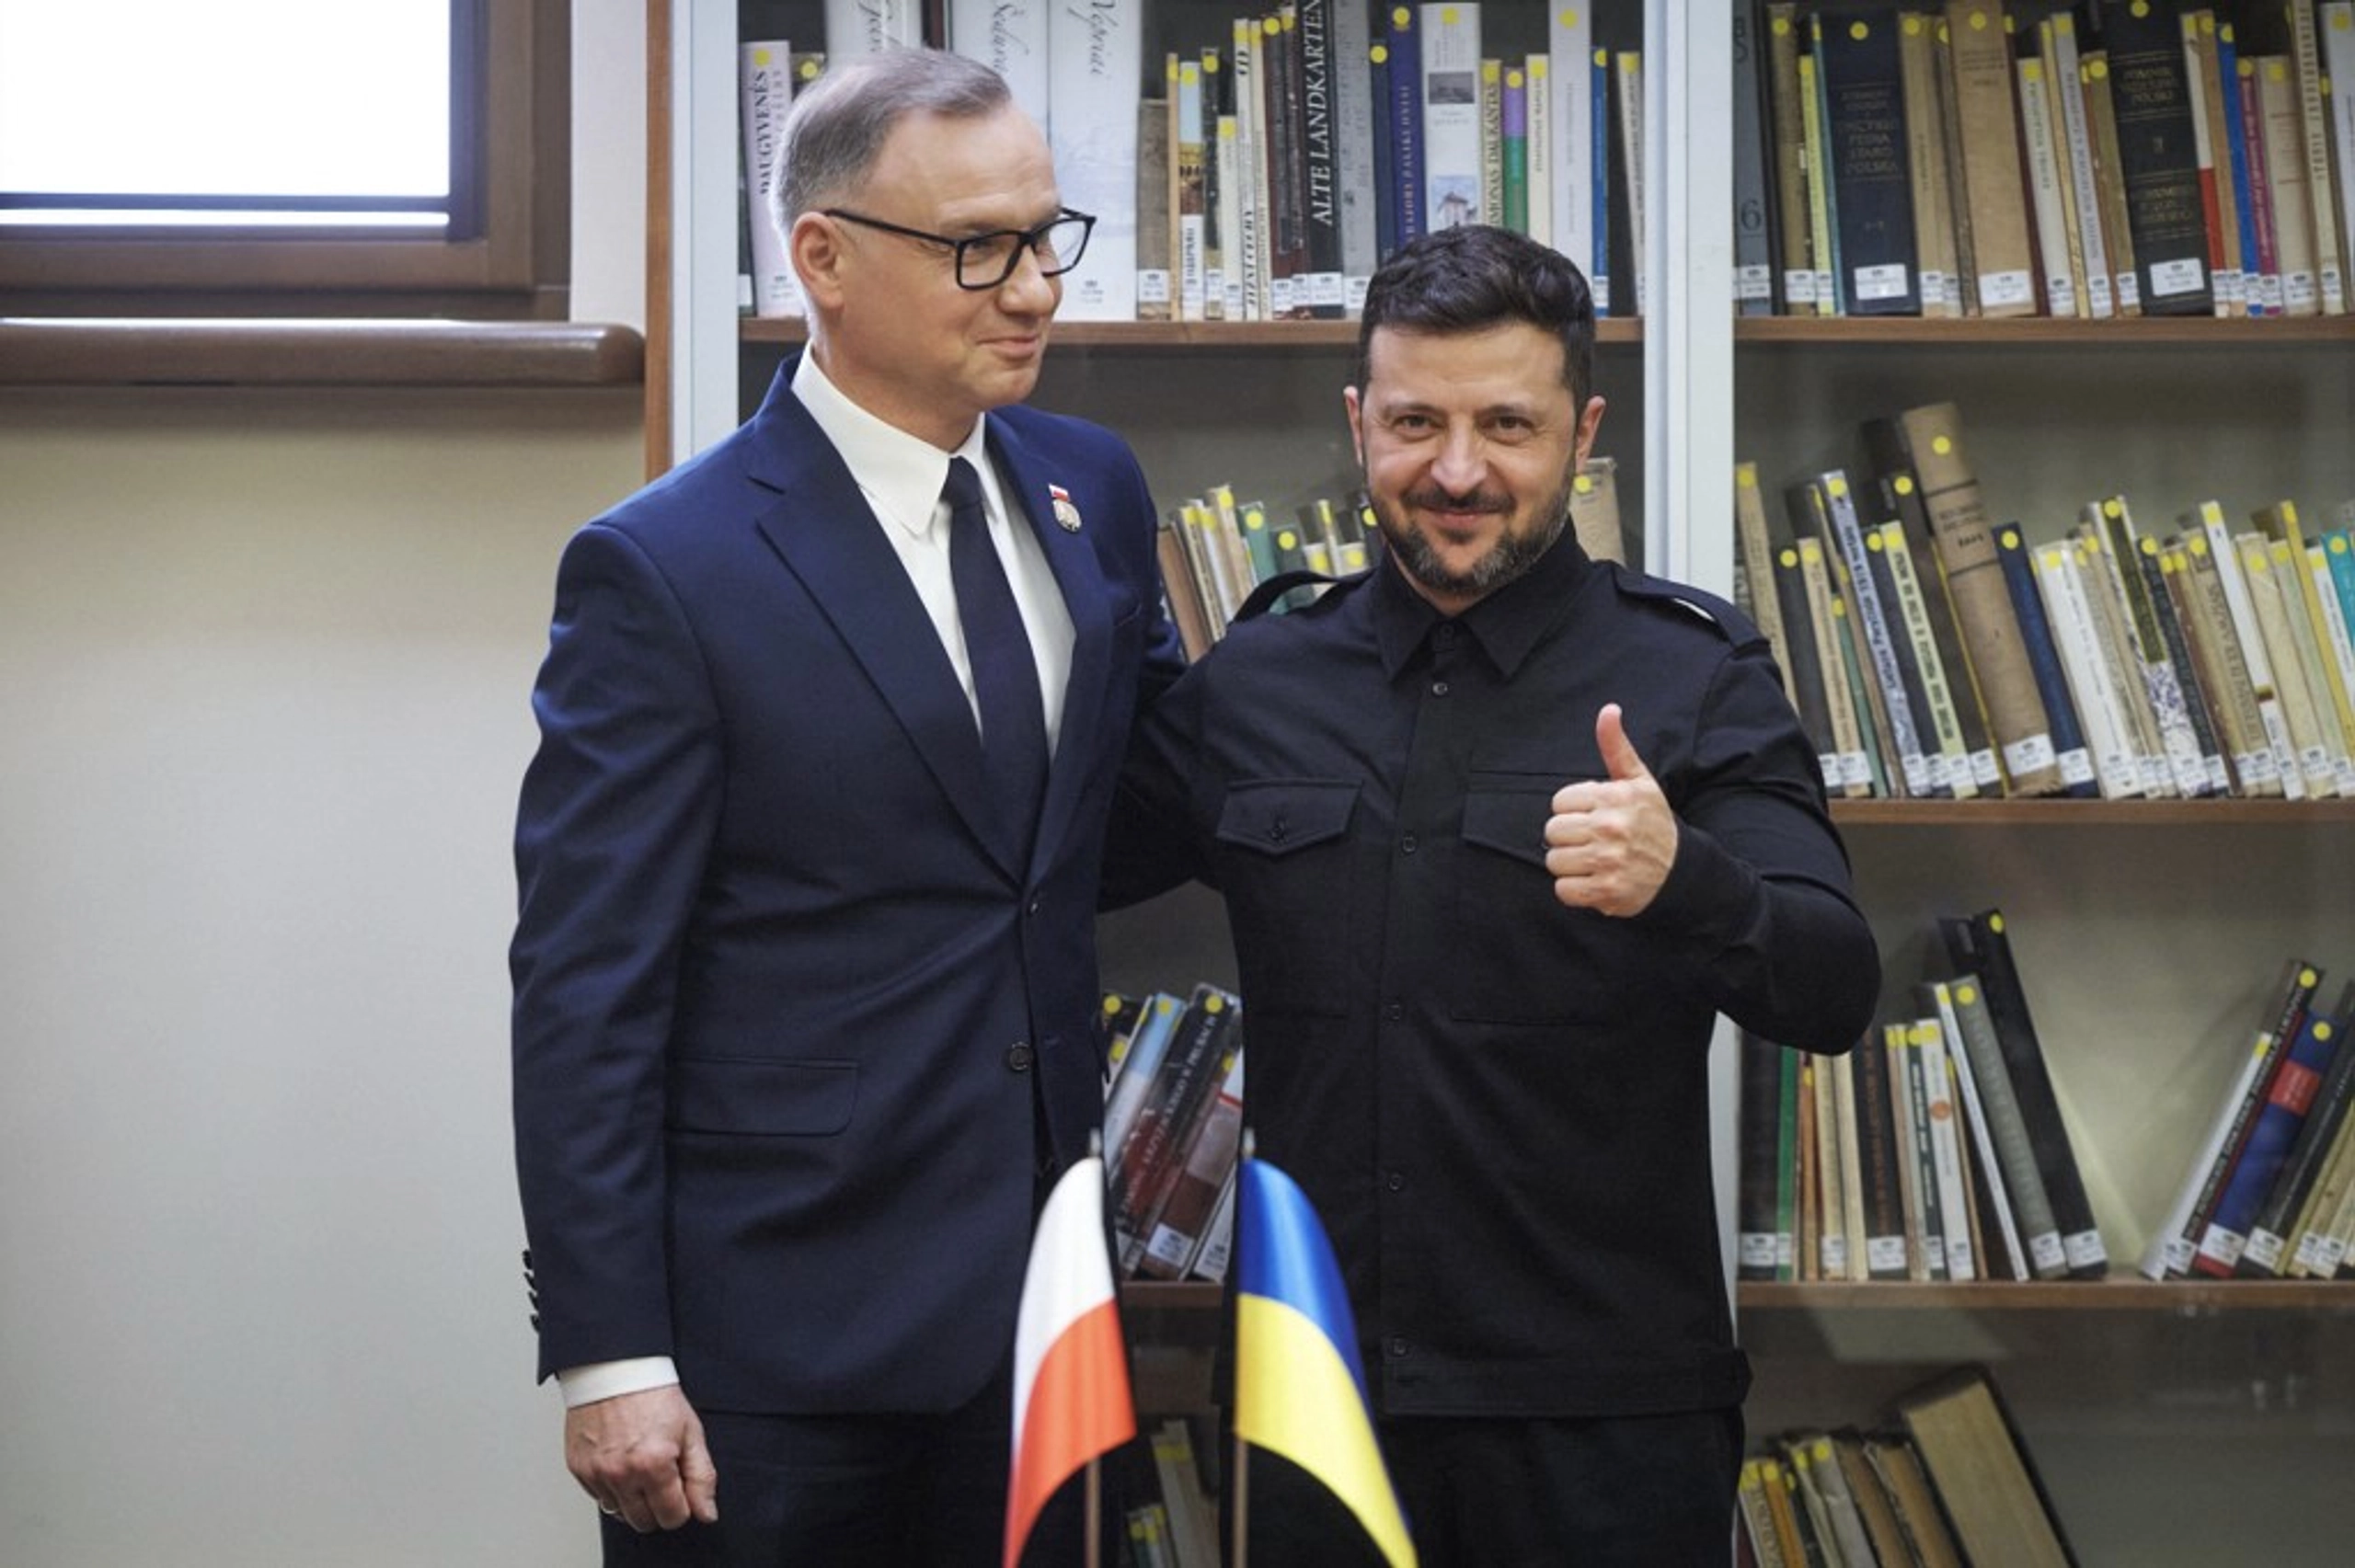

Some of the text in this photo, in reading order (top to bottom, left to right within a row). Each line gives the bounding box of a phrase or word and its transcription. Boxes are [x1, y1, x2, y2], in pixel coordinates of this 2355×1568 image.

[1303, 0, 1333, 225] ALTE LANDKARTEN
[1485, 169, 1500, 223] IMONAS
[1740, 198, 1761, 231] 6
